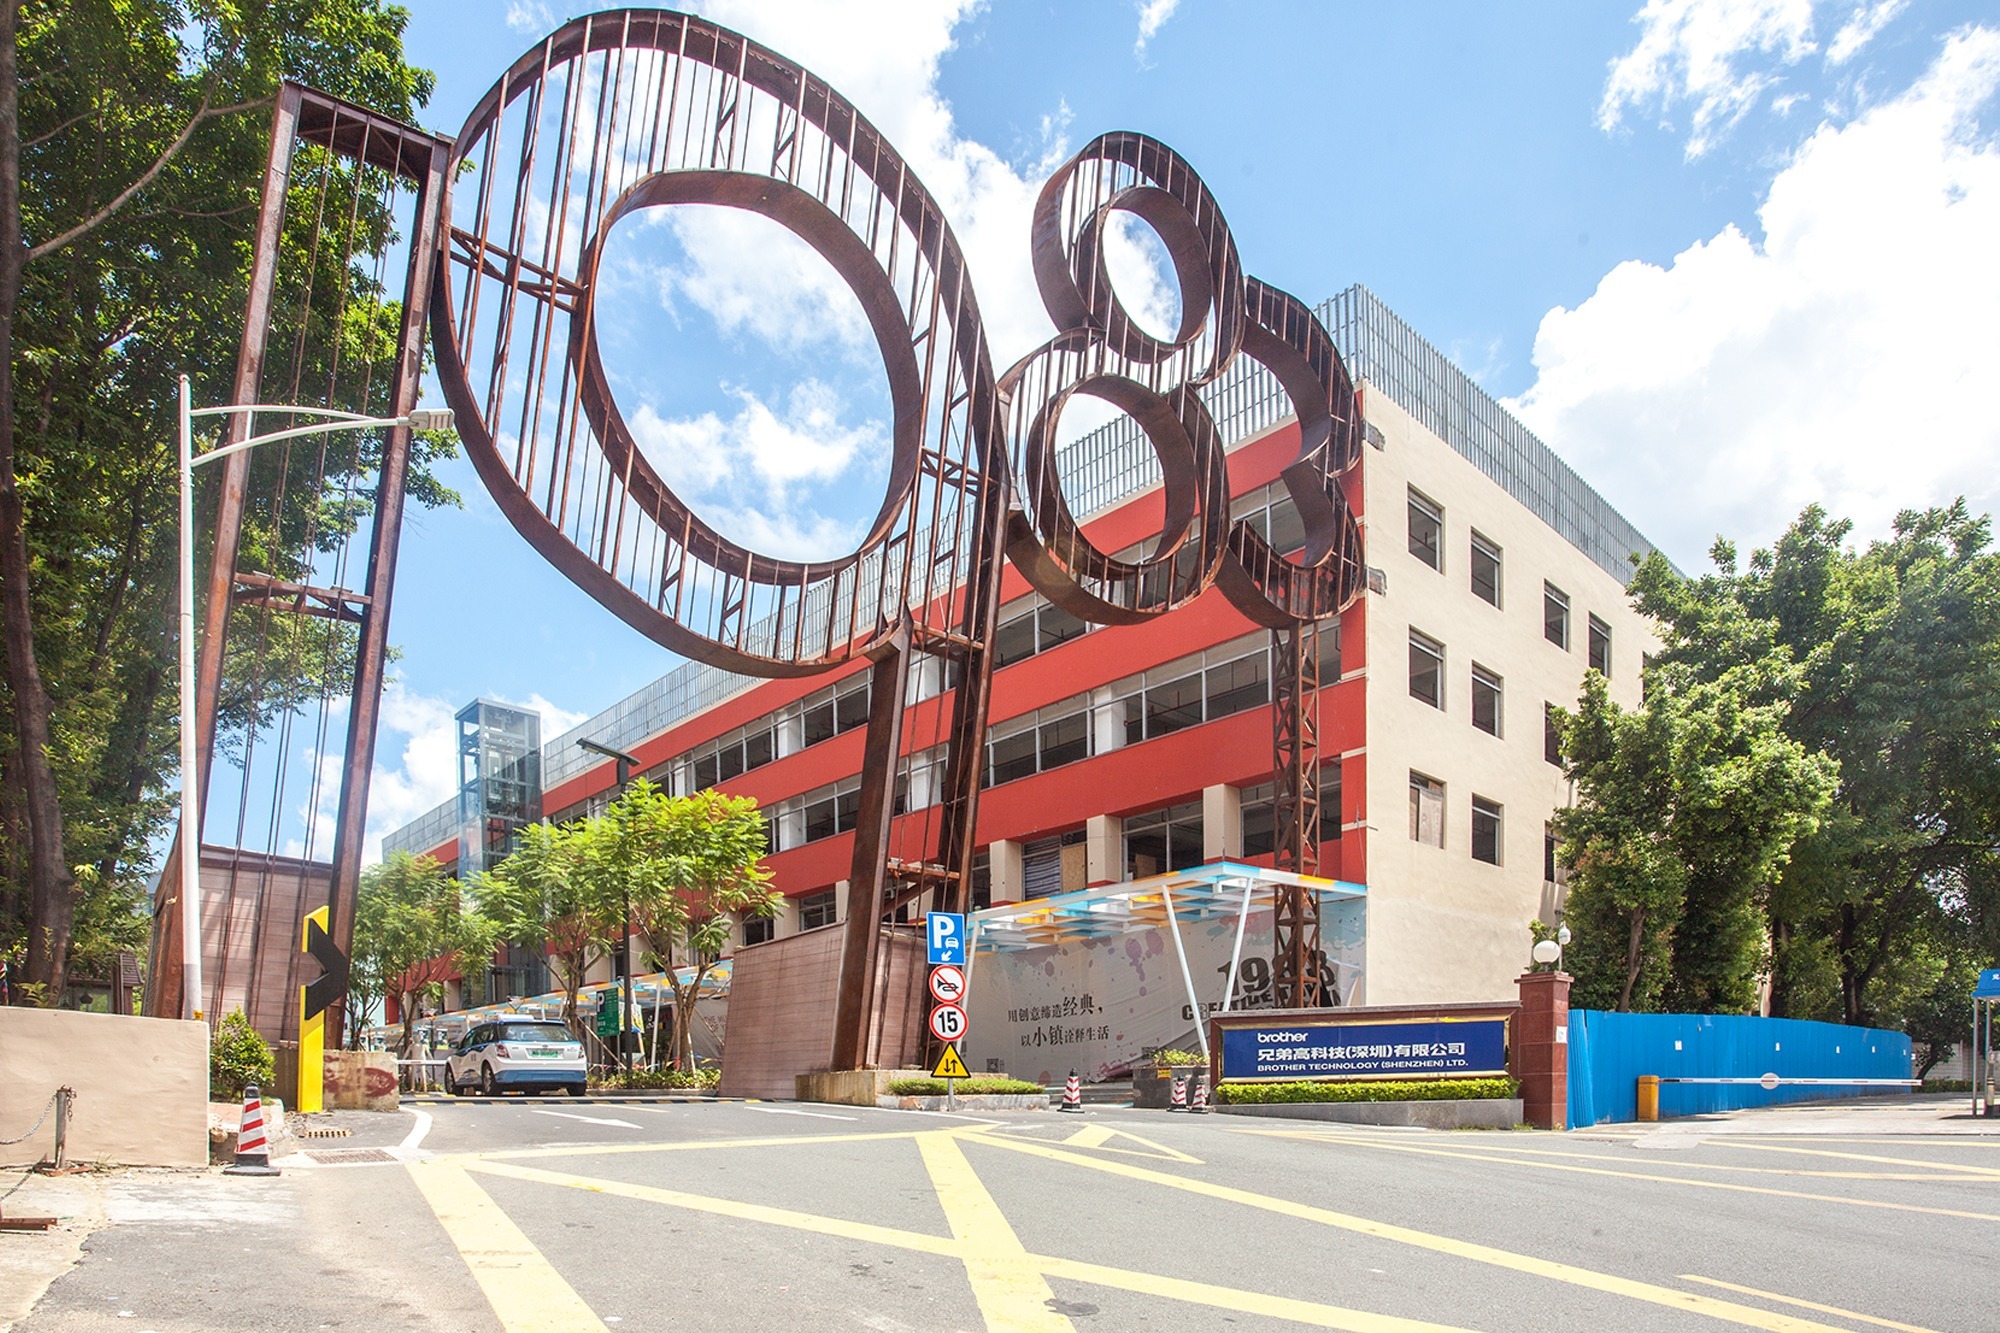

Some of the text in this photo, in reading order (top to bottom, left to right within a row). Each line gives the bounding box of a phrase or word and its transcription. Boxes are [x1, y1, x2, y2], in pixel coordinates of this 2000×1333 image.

[933, 915, 955, 948] P
[938, 1011, 958, 1033] 15
[1021, 1025, 1110, 1047] 以小镇诠释生活
[1257, 1032, 1309, 1043] brother
[1257, 1042, 1465, 1061] 兄弟高科技(深圳)有限公司
[1257, 1059, 1469, 1071] BROTHER TECHNOLOGY (SHENZHEN) LTD.
